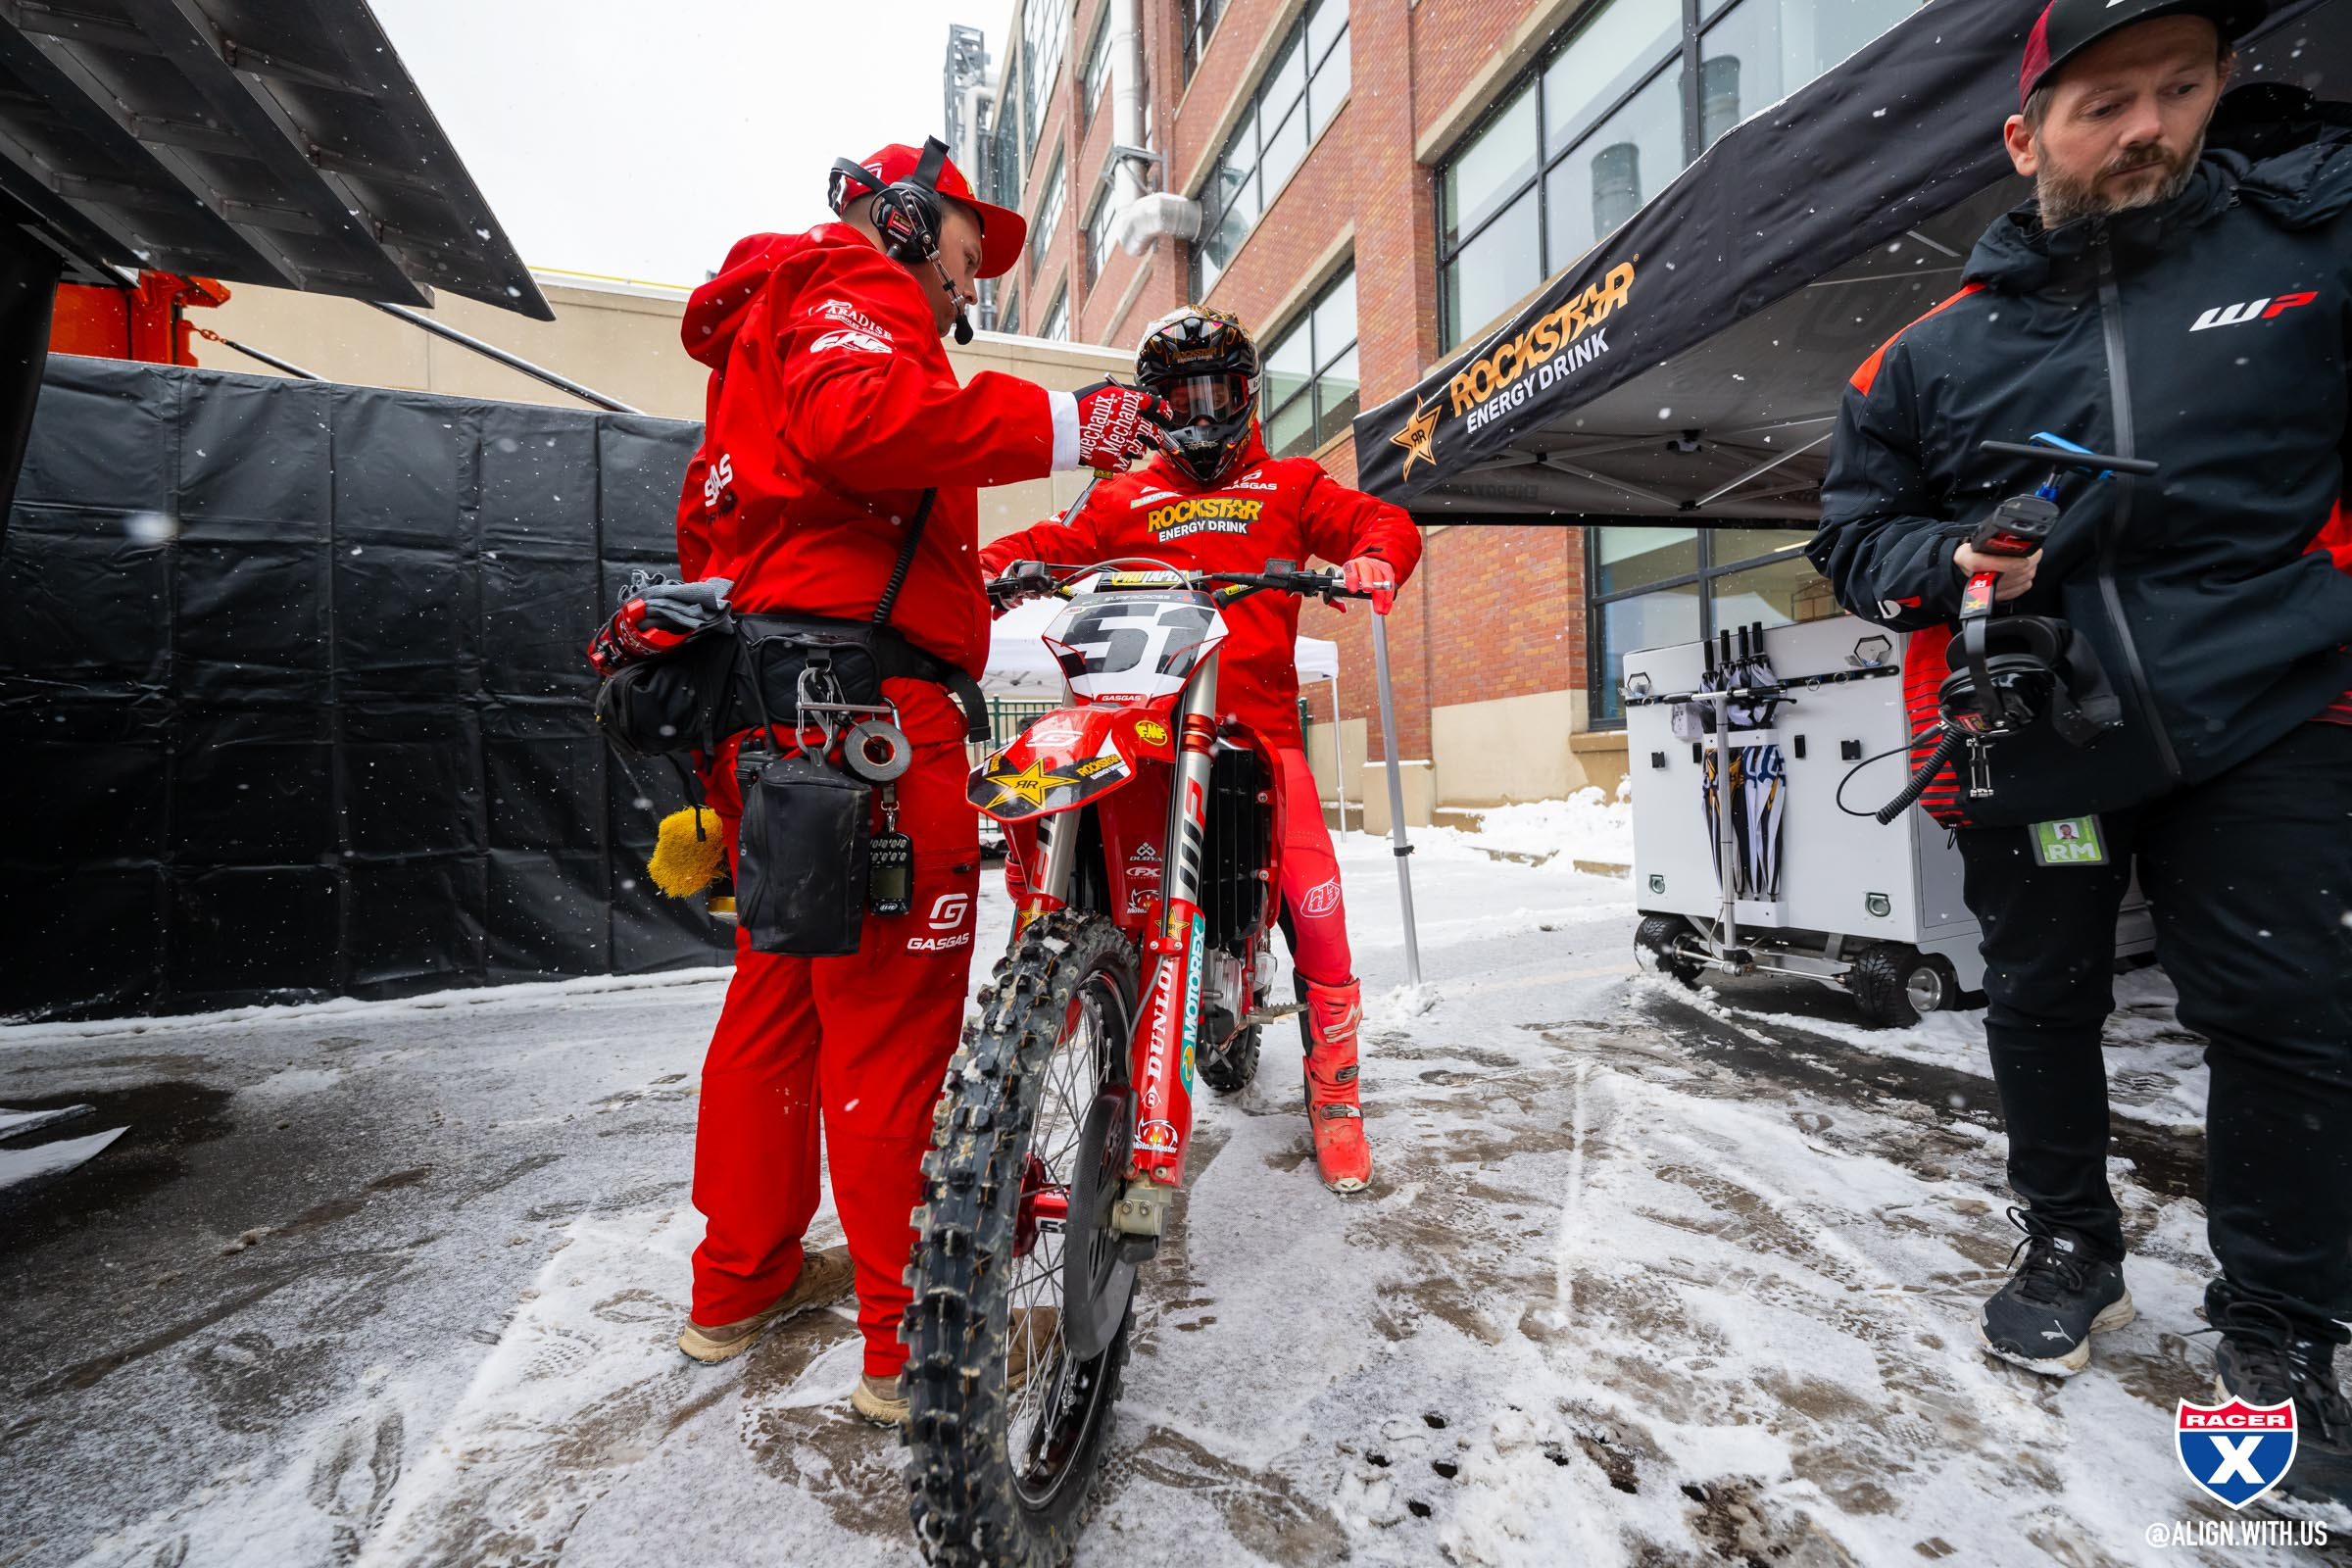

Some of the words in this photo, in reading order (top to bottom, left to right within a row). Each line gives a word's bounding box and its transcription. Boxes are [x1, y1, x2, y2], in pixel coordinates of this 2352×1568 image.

[2188, 291, 2319, 332] WP
[1449, 262, 1635, 418] ROCKSTAR
[1467, 373, 1538, 433] ENERGY
[1539, 327, 1609, 390] DRINK
[1099, 392, 1140, 457] Mechanix
[1148, 499, 1261, 533] ROCKSTAR
[1158, 520, 1205, 543] ENERGY
[1208, 520, 1247, 534] DRINK
[1058, 603, 1216, 680] 51
[1136, 724, 1166, 742] FMF
[1076, 754, 1121, 777] ROCKSTAR
[2047, 843, 2097, 860] RM
[906, 932, 970, 951] GASGAS
[1183, 924, 1204, 1043] MOTOREX
